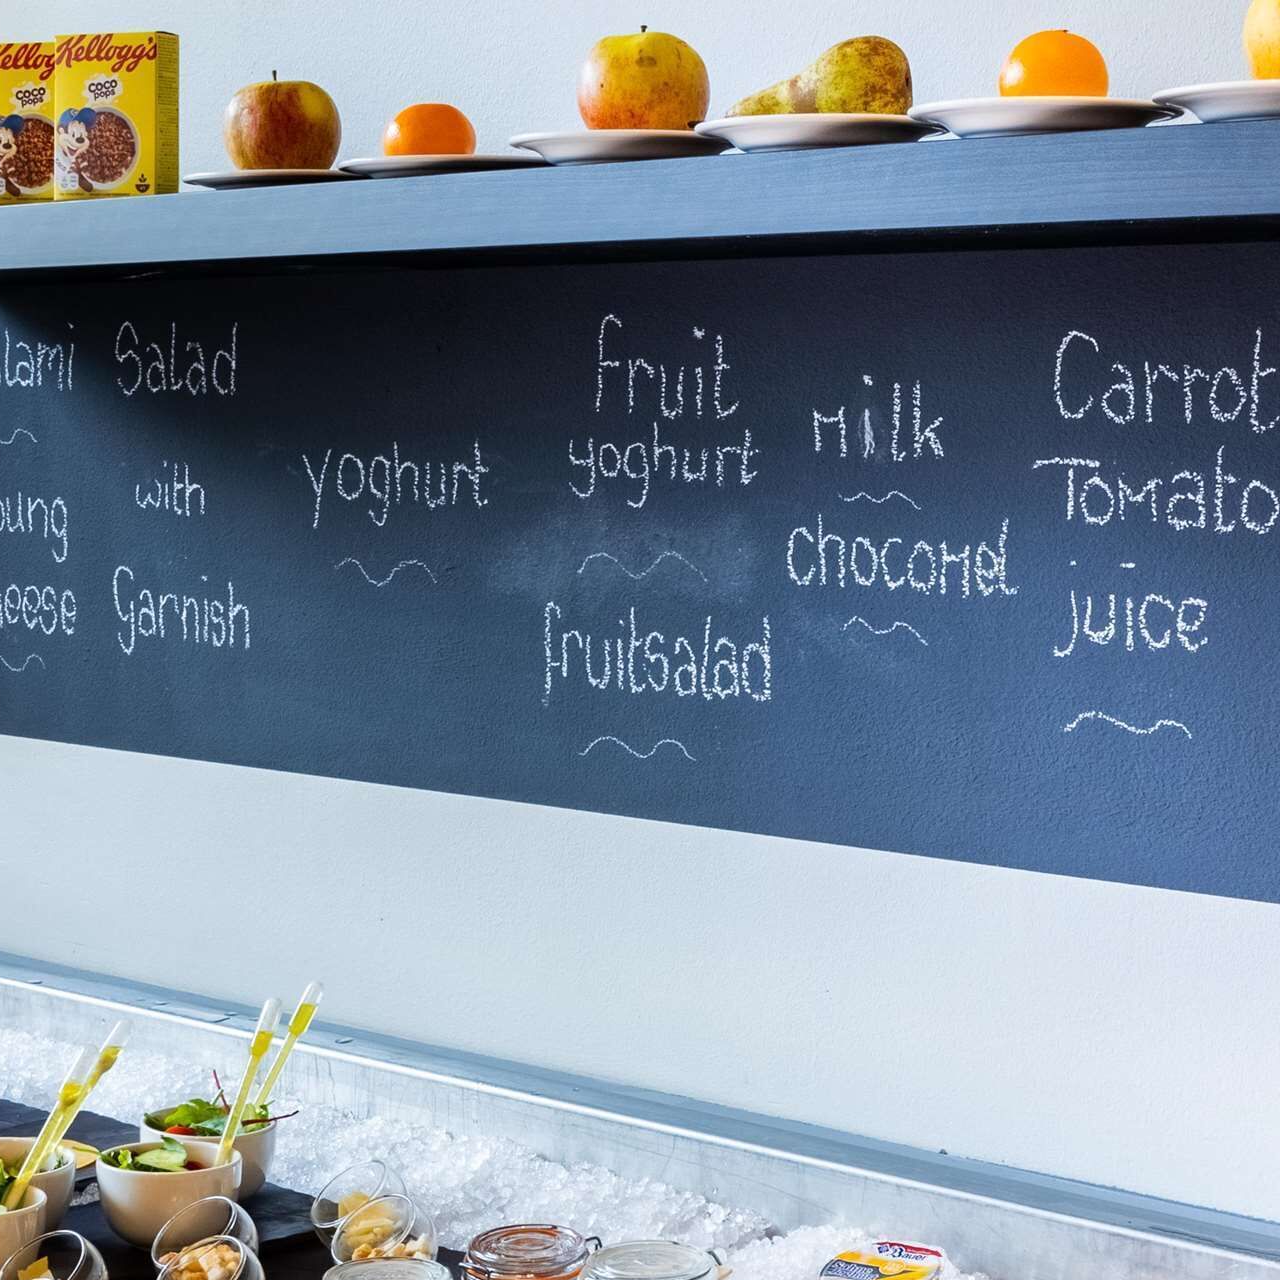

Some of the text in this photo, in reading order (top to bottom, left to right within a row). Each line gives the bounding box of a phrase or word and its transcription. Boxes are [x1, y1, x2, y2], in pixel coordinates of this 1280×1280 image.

[56, 34, 158, 72] Kellogg's
[21, 96, 44, 108] pops
[94, 89, 116, 100] pops
[114, 321, 238, 396] Salad
[1053, 326, 1280, 434] Carrot
[135, 460, 206, 517] with
[568, 421, 762, 508] yoghurt
[1031, 445, 1280, 534] Tomato
[112, 564, 250, 655] Garnish
